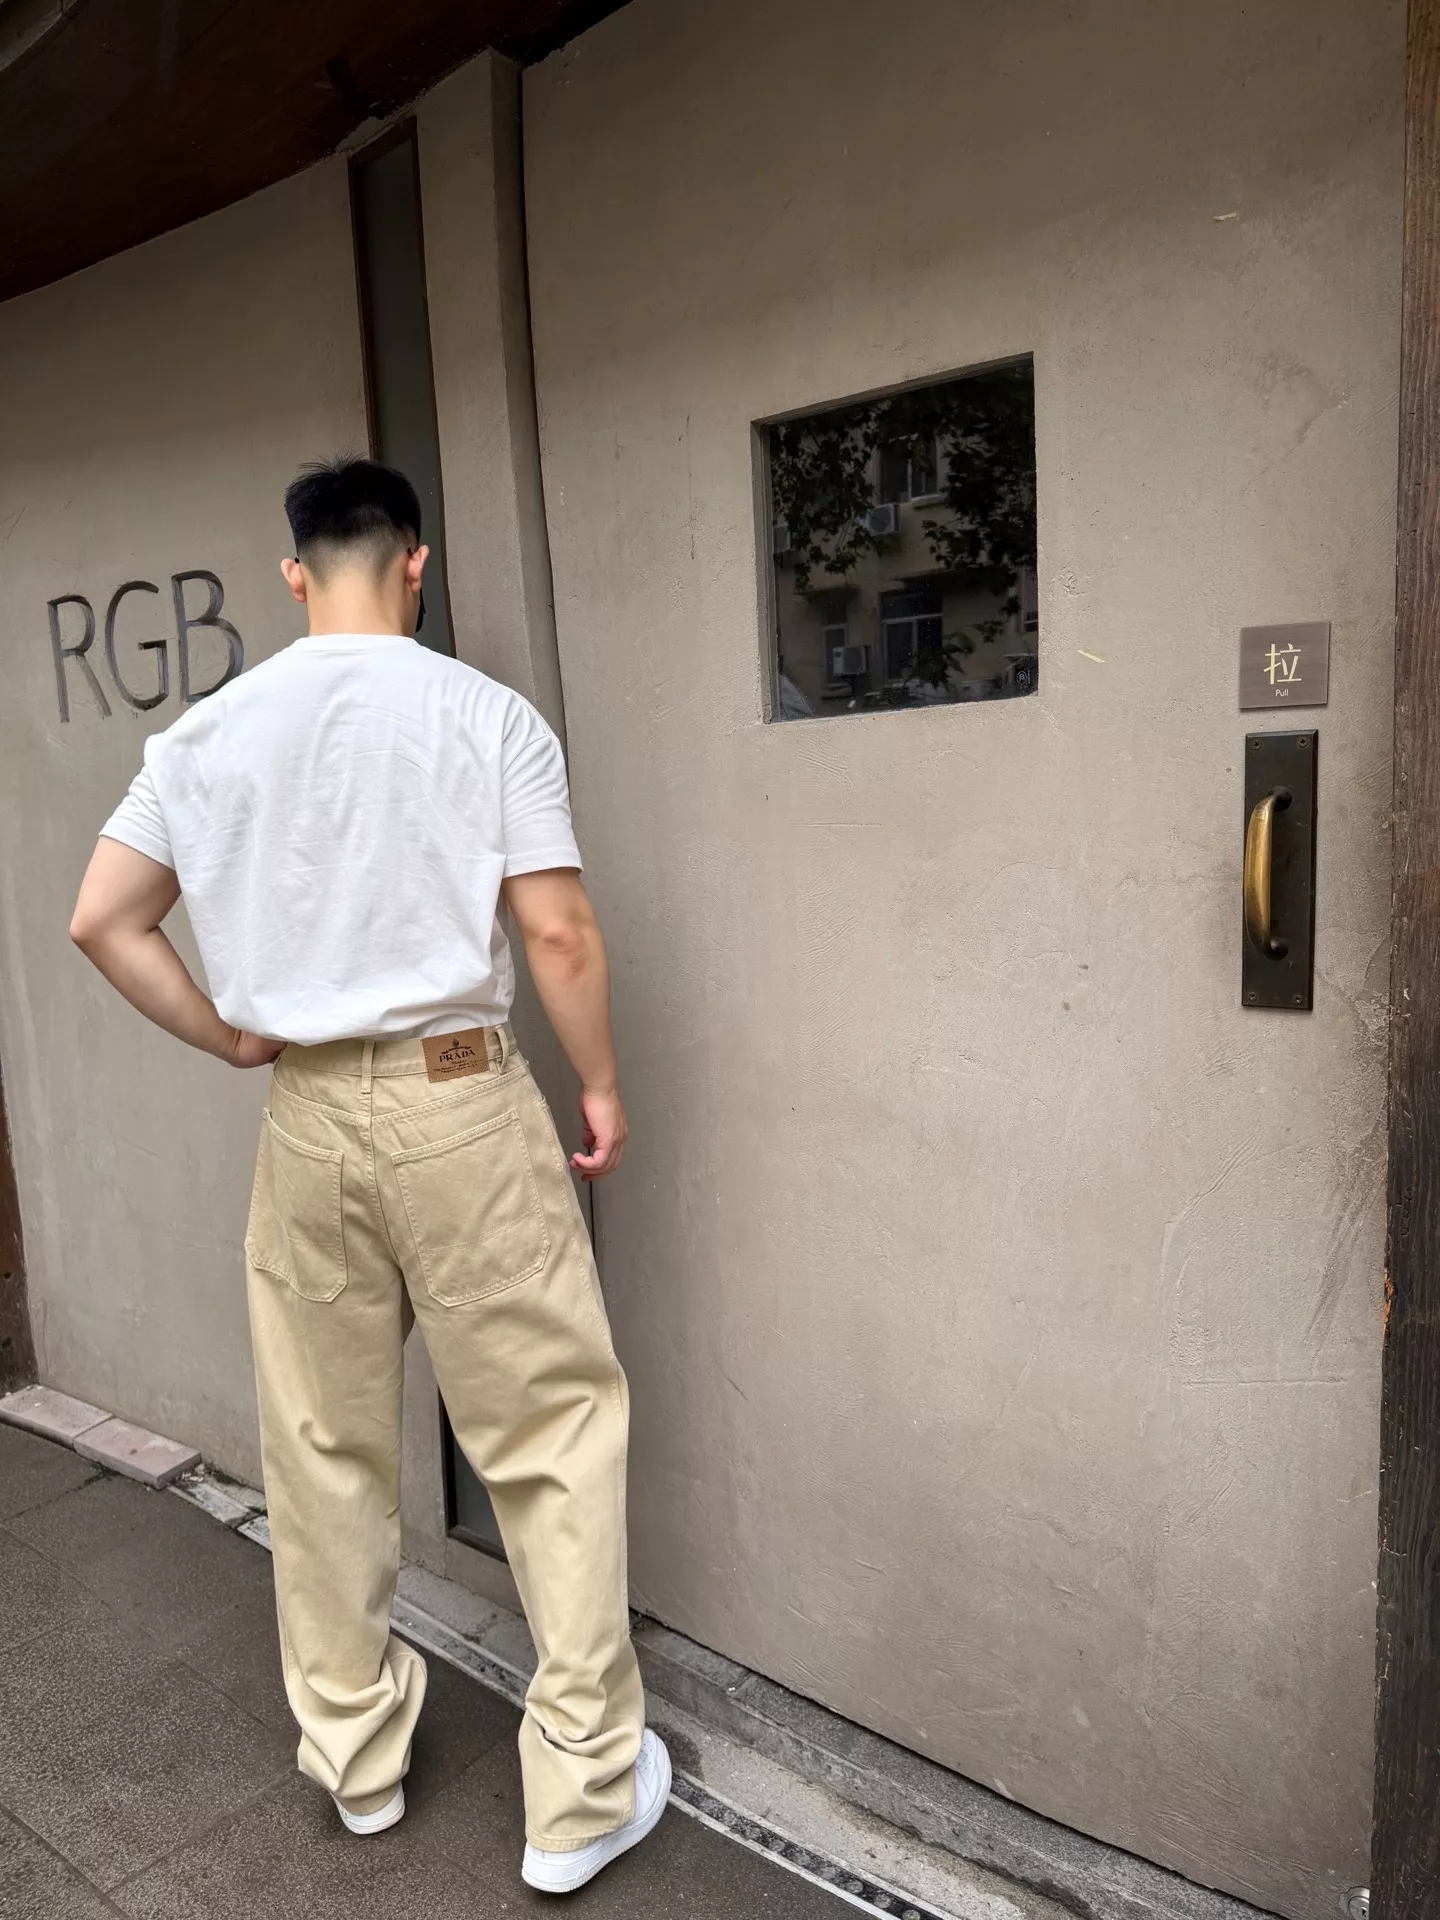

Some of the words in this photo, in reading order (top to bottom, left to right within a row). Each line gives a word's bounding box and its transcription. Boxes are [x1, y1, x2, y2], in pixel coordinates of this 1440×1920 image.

[47, 569, 244, 723] RGB
[1263, 642, 1302, 685] 拉
[1275, 688, 1289, 697] Pull
[438, 1049, 476, 1063] PRADA
